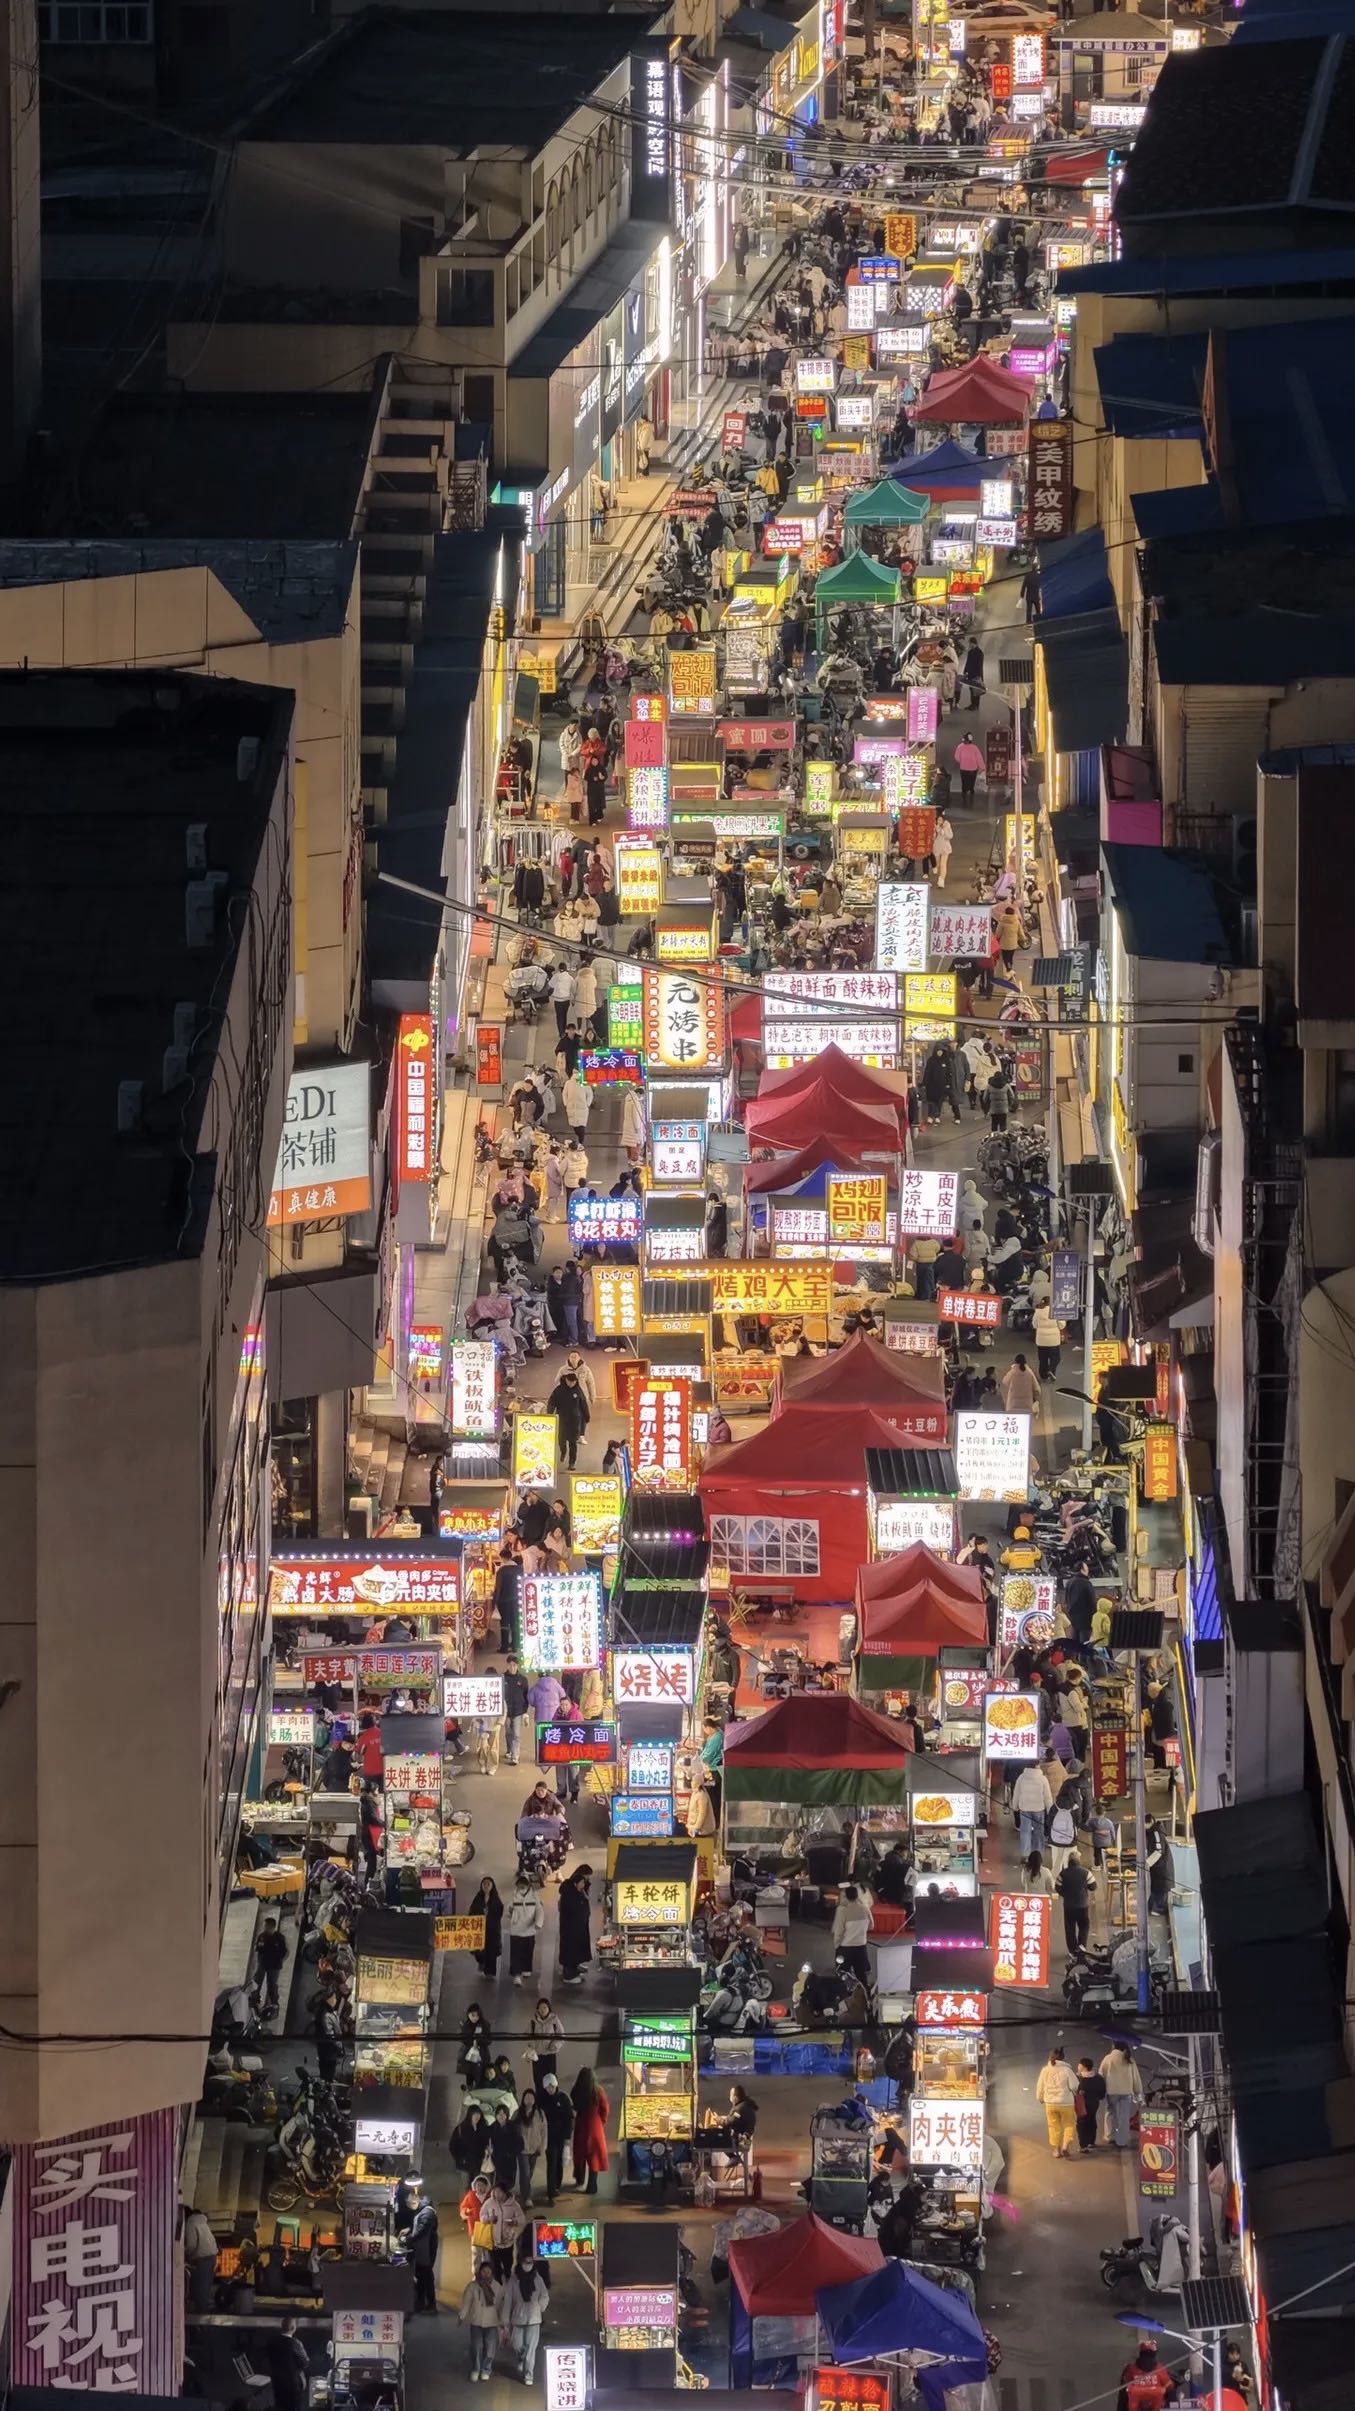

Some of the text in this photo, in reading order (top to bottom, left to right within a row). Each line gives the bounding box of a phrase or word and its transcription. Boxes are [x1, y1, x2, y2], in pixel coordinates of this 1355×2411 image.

[799, 361, 832, 375] 牛排意面
[1034, 442, 1063, 534] 美甲纹绣
[672, 655, 714, 674] 鸡翅
[673, 675, 714, 697] 包饭
[931, 916, 988, 934] 脆皮肉夹馍
[931, 937, 984, 955] 泡菜臭豆腐
[790, 976, 837, 998] 朝鲜面
[843, 977, 893, 1000] 酸辣粉
[667, 982, 701, 1062] 元烤串
[767, 1027, 892, 1043] 特色泡菜 朝鲜面 酸辣粉
[585, 1055, 639, 1069] 烤冷面
[658, 1125, 699, 1139] 烤冷面
[281, 1127, 337, 1174] 茶铺
[658, 1159, 698, 1175] 臭豆腐
[832, 1177, 882, 1199] 鸡翅
[288, 1186, 337, 1213] 真健康
[832, 1201, 882, 1222] 包饭
[903, 1208, 952, 1226] 热干面
[581, 1220, 639, 1238] 花枝丸
[714, 1274, 829, 1298] 烤鸡大全
[941, 1296, 998, 1322] 单饼卷豆腐
[888, 1335, 937, 1350] 单饼卷豆腐
[464, 1369, 484, 1429] 铁板鱿鱼
[903, 1417, 938, 1434] 土豆粉
[964, 1416, 1019, 1434] 口口福
[1152, 1438, 1169, 1496] 中国黄金
[880, 1520, 951, 1538] 铁板鱿鱼 烧烤
[1037, 1584, 1050, 1611] 炒面
[360, 1655, 434, 1676] 泰国莲子粥
[446, 1691, 501, 1713] 夹饼 卷饼
[273, 1716, 316, 1729] 羊肉串
[545, 1727, 610, 1744] 烤冷面
[986, 1731, 1036, 1749] 大鸡排
[631, 1751, 669, 1766] 烤冷面
[1100, 1732, 1118, 1797] 中国黄金
[384, 1767, 441, 1789] 夹饼 卷饼
[623, 1885, 681, 1903] 车轮饼
[623, 1904, 681, 1922] 烤冷面
[359, 2127, 410, 2149] 一元寿司
[912, 2112, 982, 2148] 肉夹馍
[818, 2379, 881, 2397] 酸辣粉
